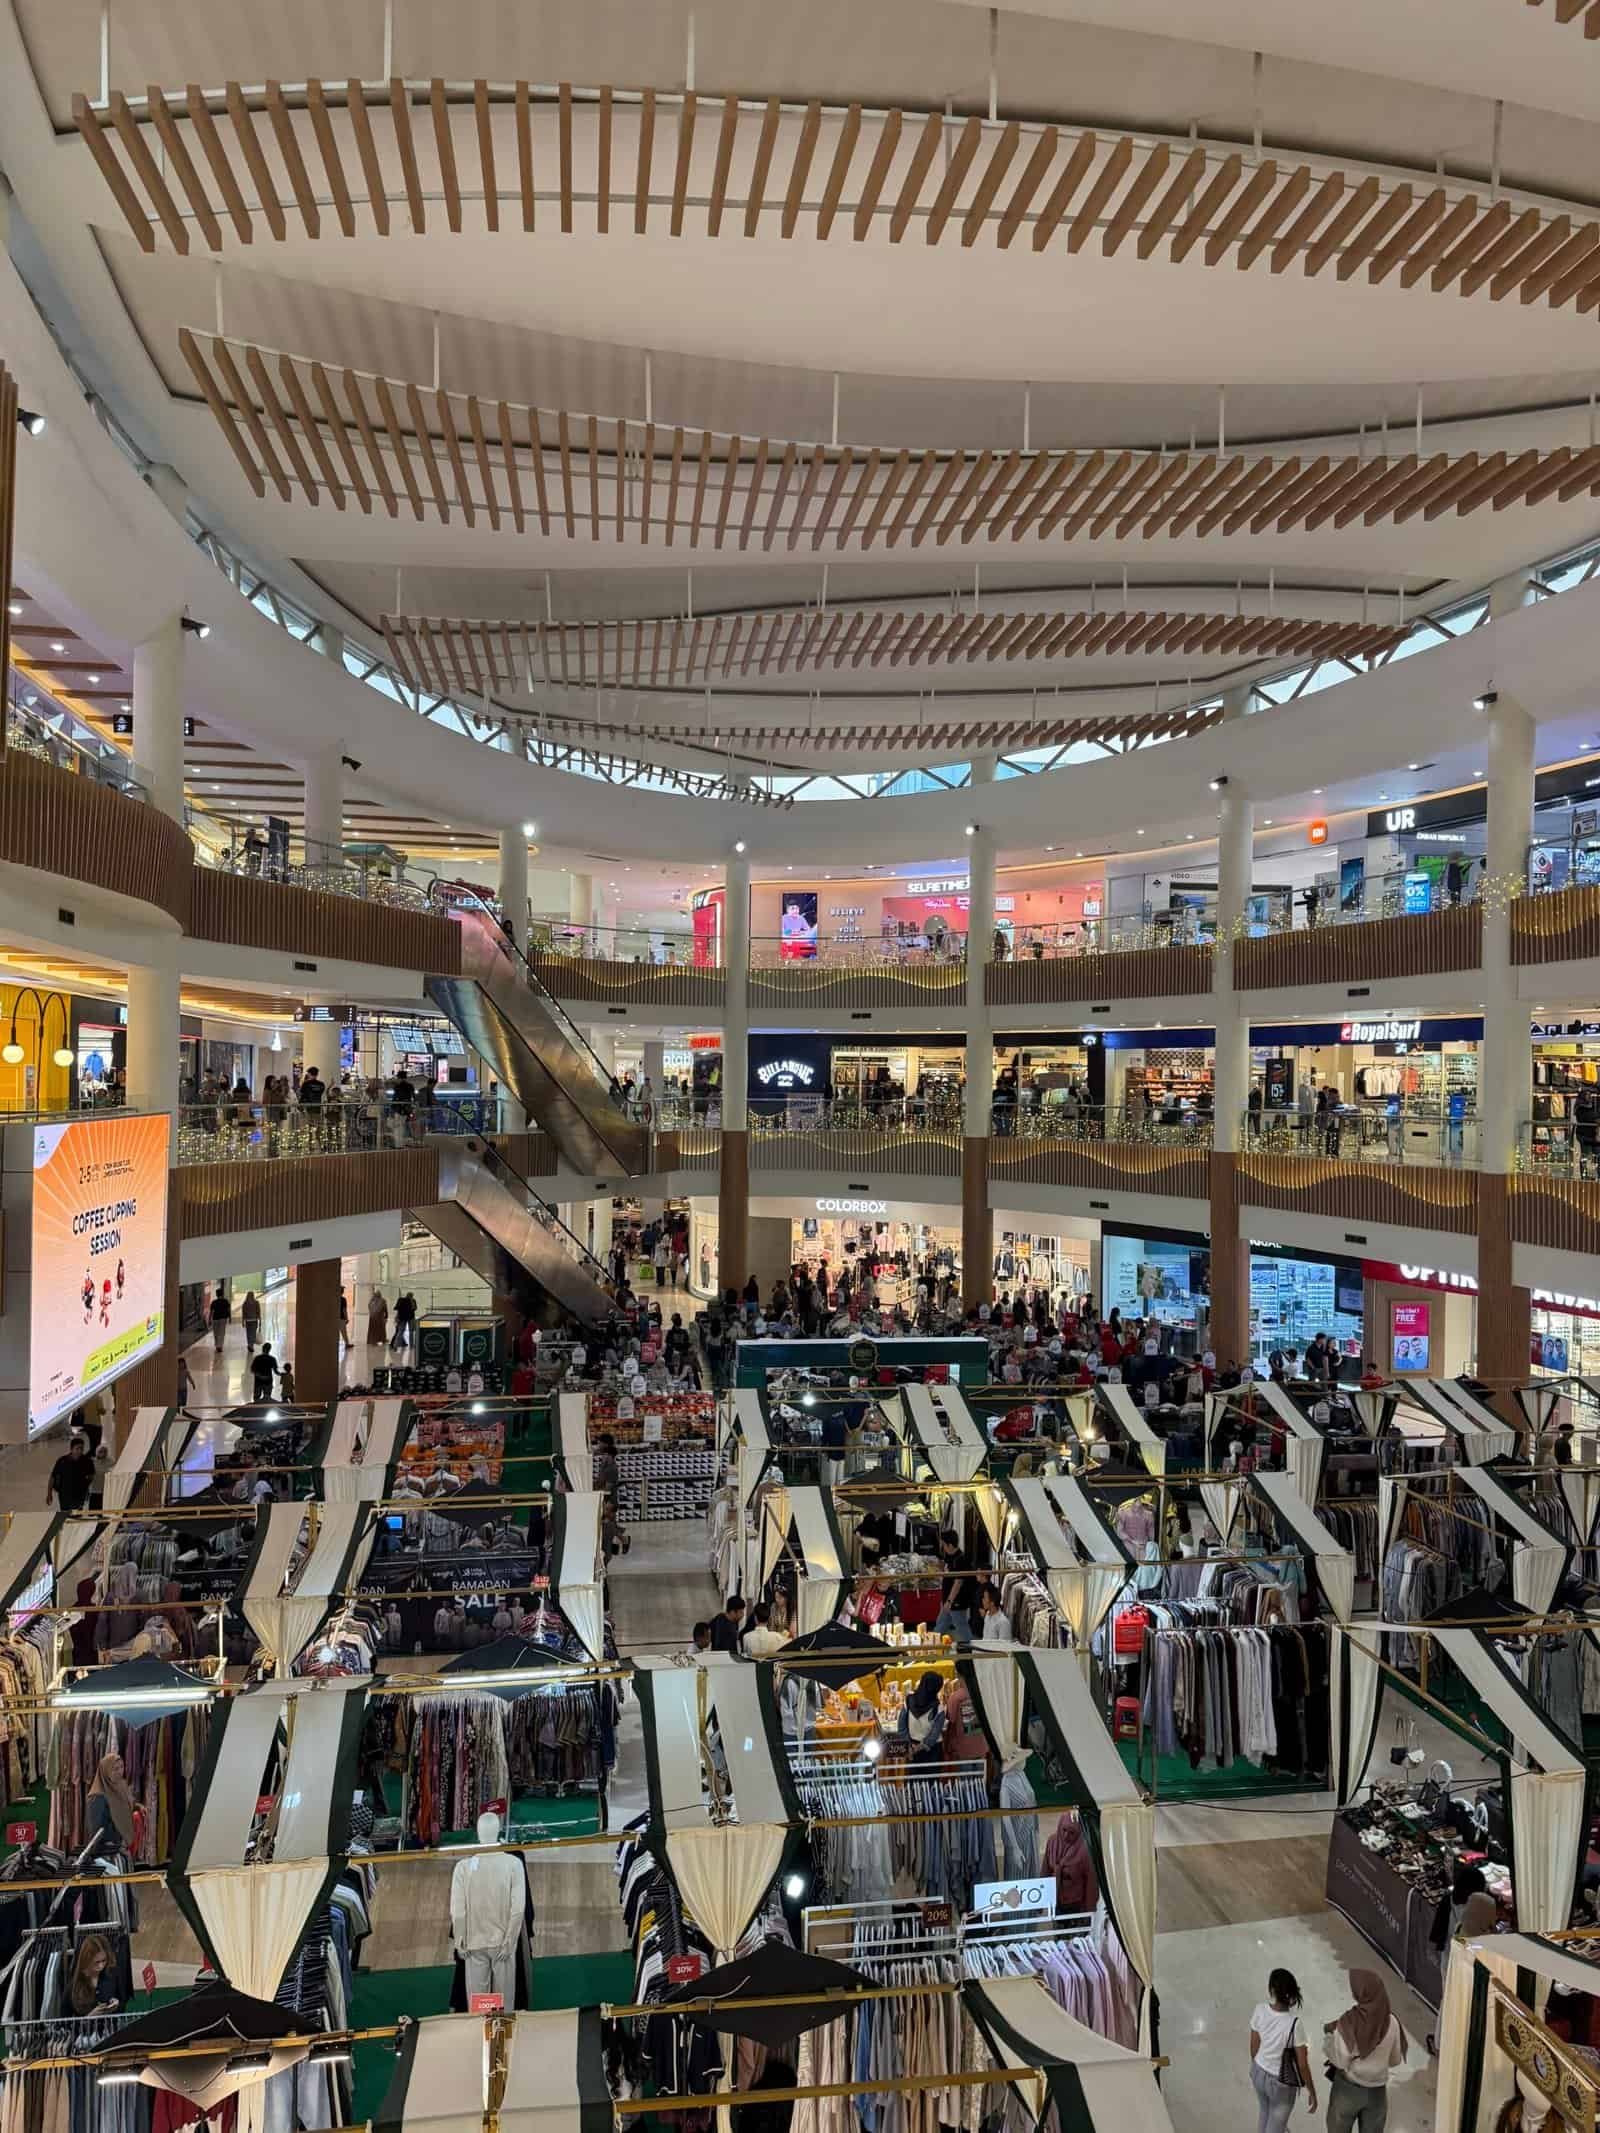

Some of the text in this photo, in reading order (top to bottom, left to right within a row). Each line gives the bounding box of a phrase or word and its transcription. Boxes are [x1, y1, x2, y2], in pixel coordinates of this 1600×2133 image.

[1386, 808, 1415, 831] UR
[757, 1060, 815, 1085] BILLABONG
[816, 1199, 887, 1213] COLORBOX
[72, 1199, 136, 1235] COFFEE CUPPING
[90, 1228, 121, 1252] SESSION
[1395, 1314, 1416, 1322] FREE
[452, 1580, 511, 1590] RAMADAN
[200, 1592, 235, 1601] RAMA
[926, 1910, 949, 1921] 20%
